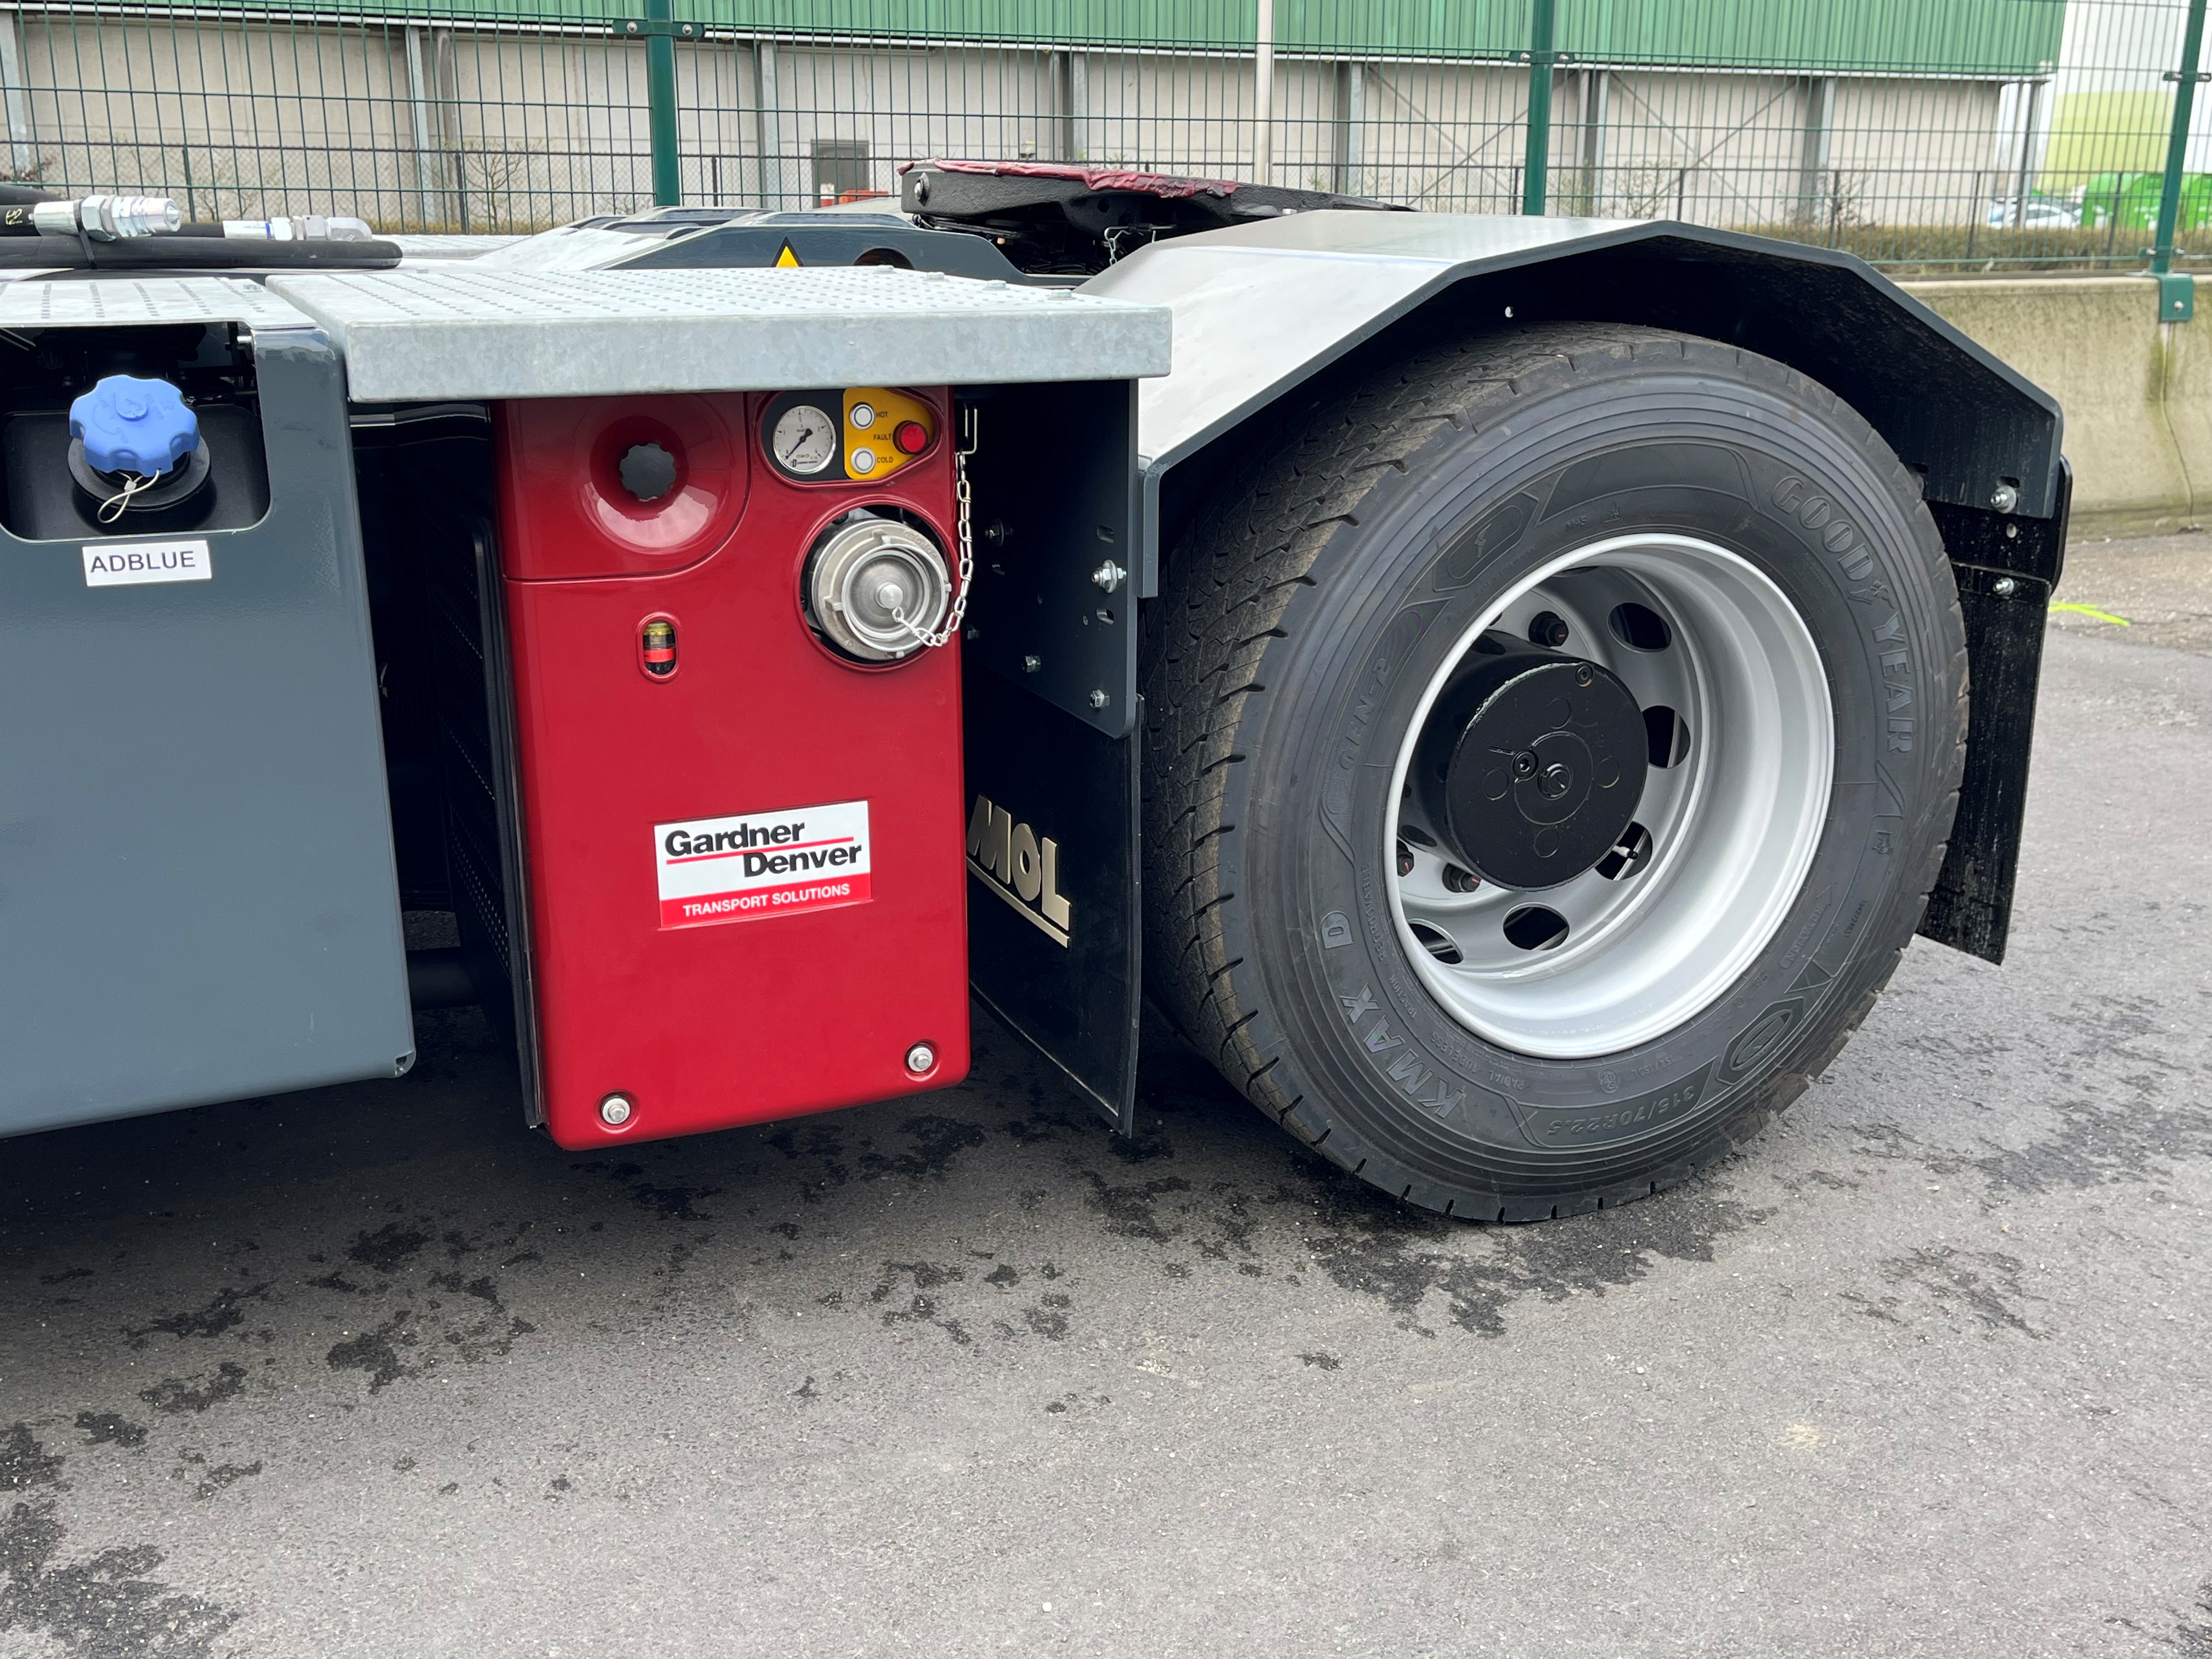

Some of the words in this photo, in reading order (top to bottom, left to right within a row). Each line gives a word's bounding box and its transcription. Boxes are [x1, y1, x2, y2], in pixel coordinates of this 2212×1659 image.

[89, 550, 196, 573] ADBLUE
[1770, 476, 1914, 754] GOODYEAR
[664, 821, 805, 857] Gardner
[743, 841, 862, 878] Denver
[967, 794, 1071, 930] MOL
[683, 894, 769, 917] TRANSPORT
[772, 884, 850, 906] SOLUTIONS
[1361, 863, 1386, 962] REGROOVABLE
[1321, 910, 1354, 950] D
[1784, 905, 1824, 962] ROTATION
[1389, 974, 1417, 1019] TRACTION
[1339, 982, 1466, 1119] KMAX
[1430, 1034, 1477, 1075] TUBELESS
[1488, 1070, 1528, 1091] RADIAL
[1547, 1085, 1695, 1136] 315/70R22.5
